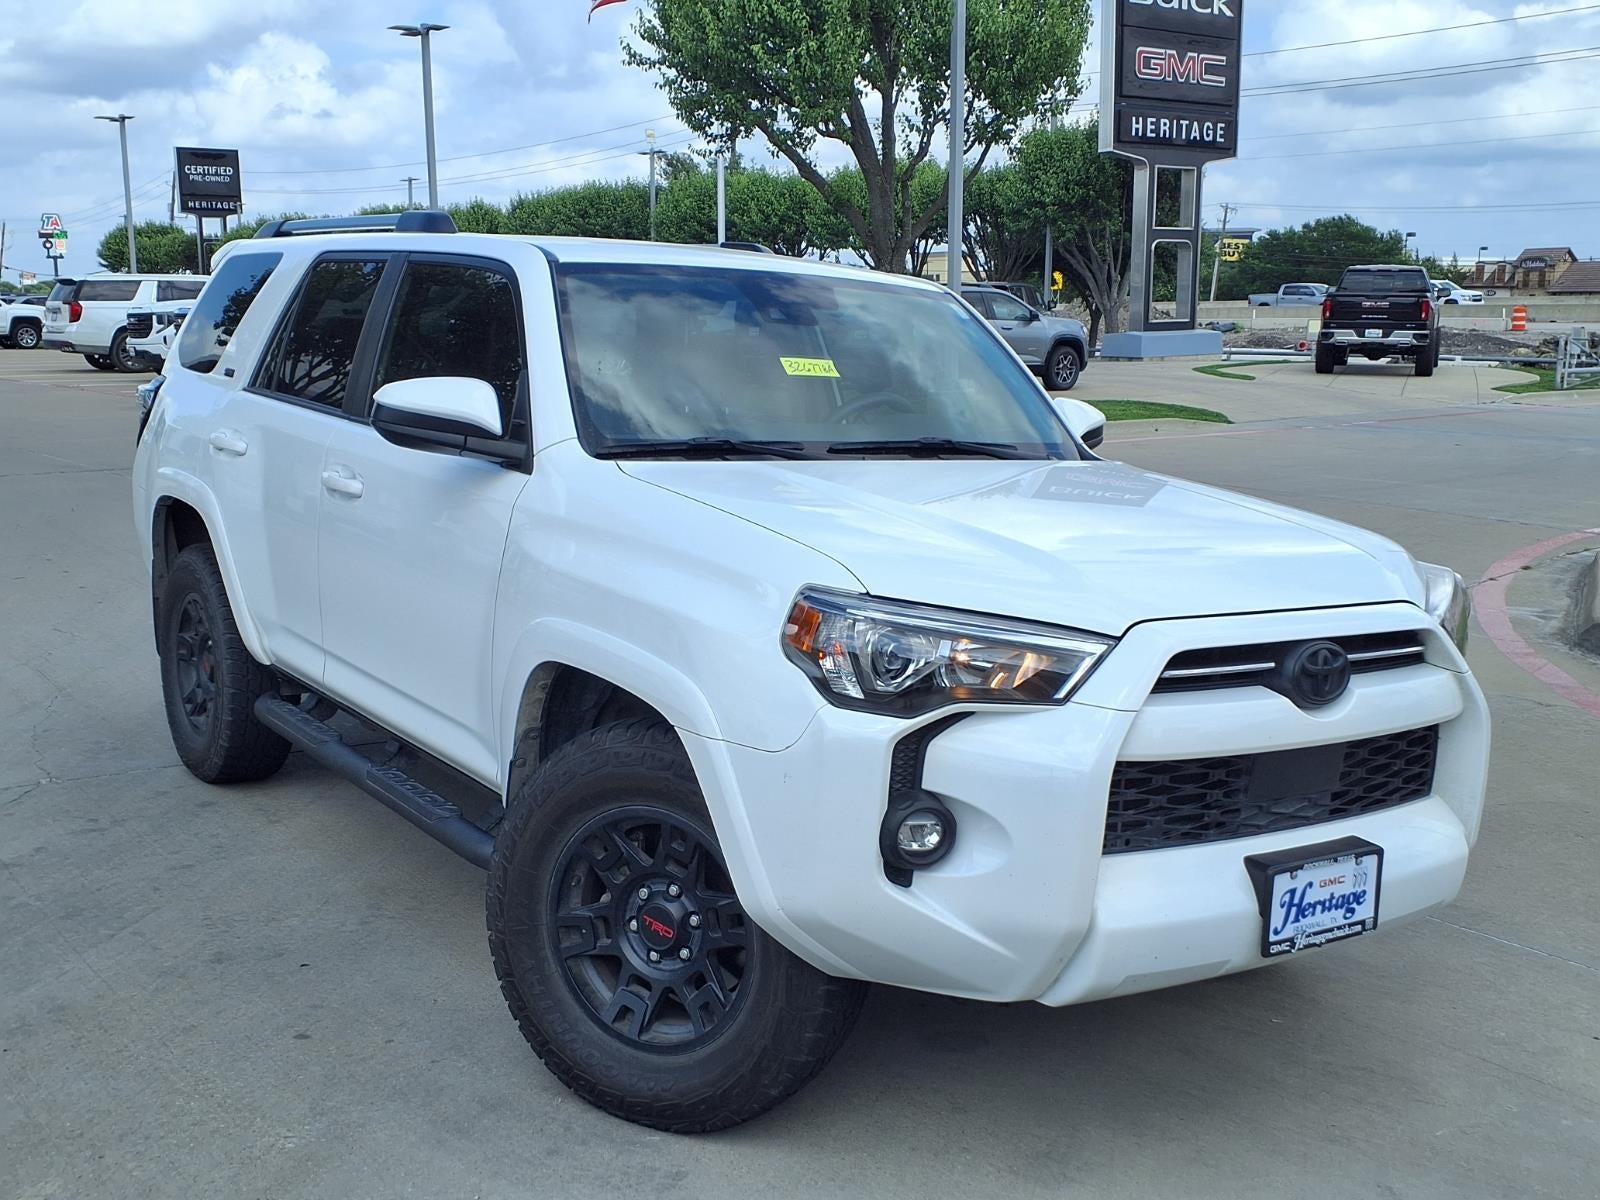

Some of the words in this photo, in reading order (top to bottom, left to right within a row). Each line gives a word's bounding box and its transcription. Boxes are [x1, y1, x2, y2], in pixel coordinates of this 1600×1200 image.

[1136, 46, 1227, 87] GMC
[1131, 116, 1226, 143] HERITAGE
[184, 165, 233, 175] CERTIFIED
[189, 174, 230, 182] PRE-OWNED
[188, 200, 236, 209] HERITAGE
[43, 215, 61, 228] TA
[1319, 875, 1346, 888] GMC
[1272, 881, 1367, 936] Heritage
[643, 915, 673, 938] TRD
[1269, 942, 1291, 953] GMC
